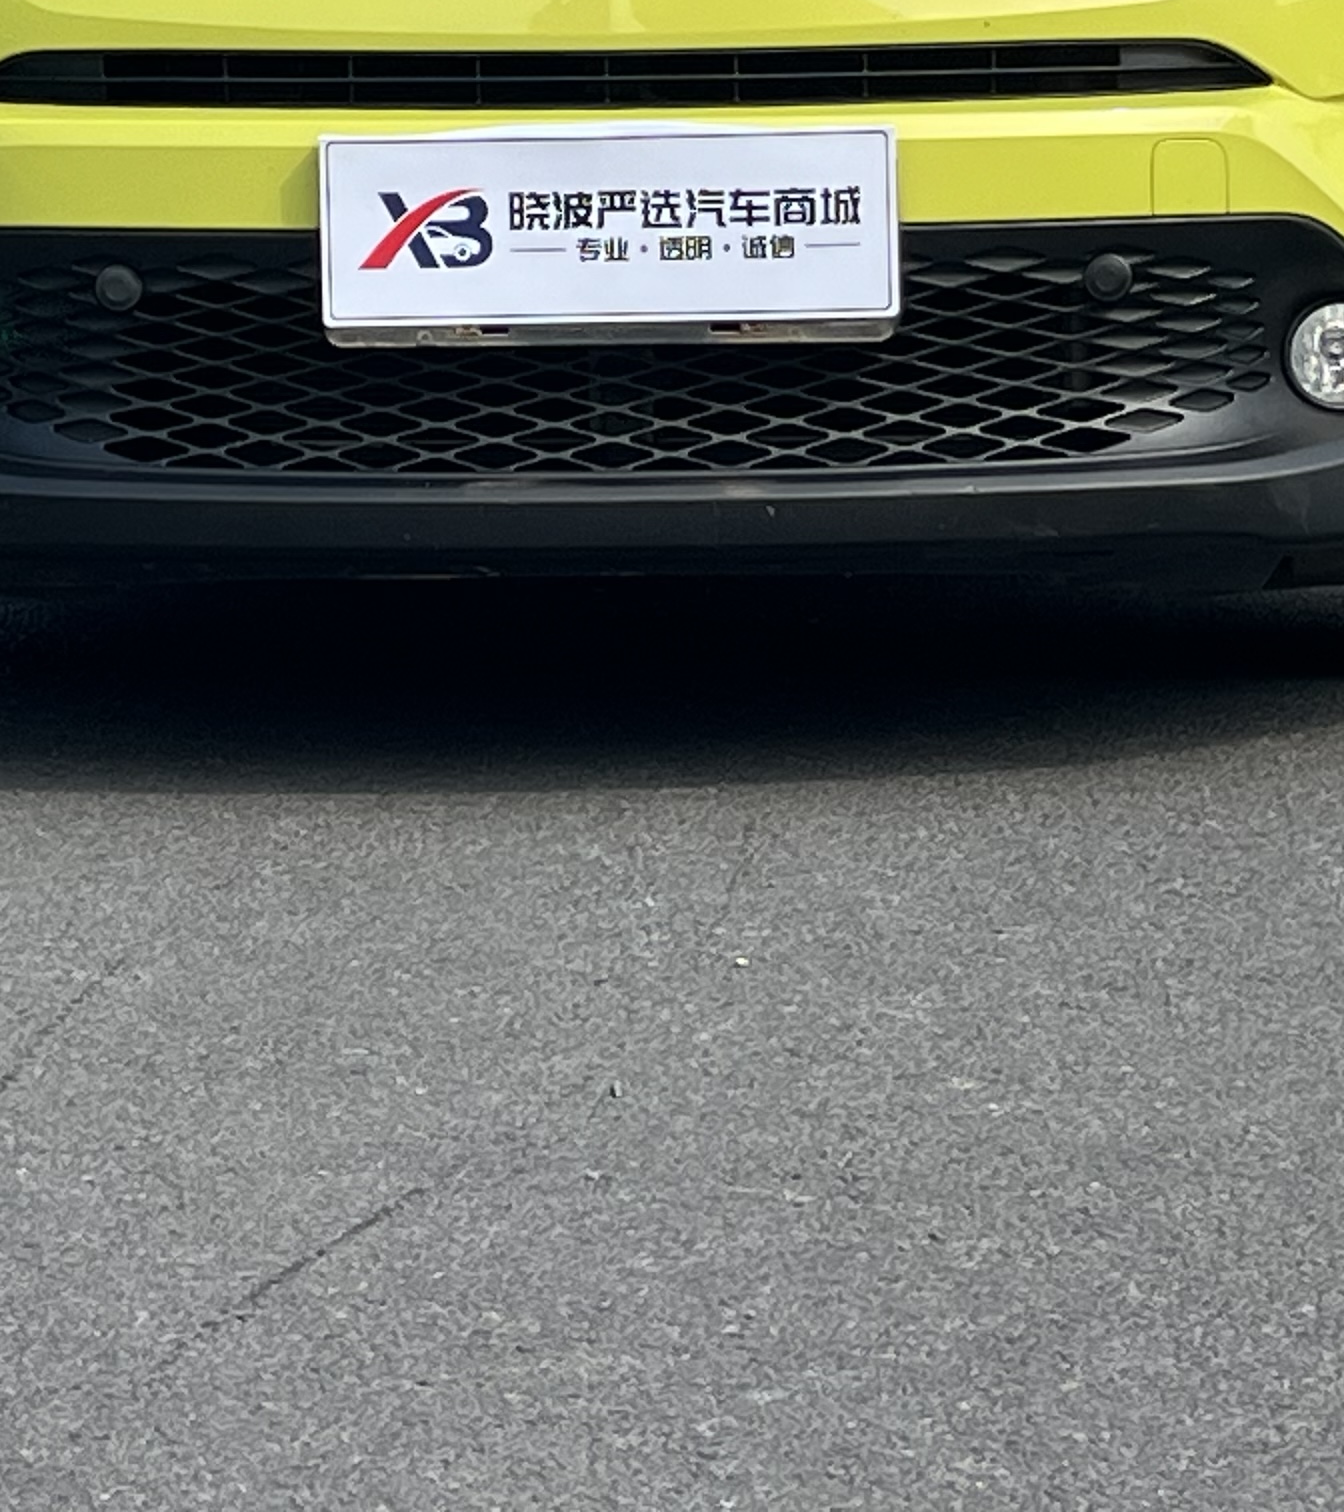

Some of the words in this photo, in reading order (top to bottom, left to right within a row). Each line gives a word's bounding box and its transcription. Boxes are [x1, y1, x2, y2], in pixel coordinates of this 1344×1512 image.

[508, 186, 862, 231] 晓波严选汽车商城
